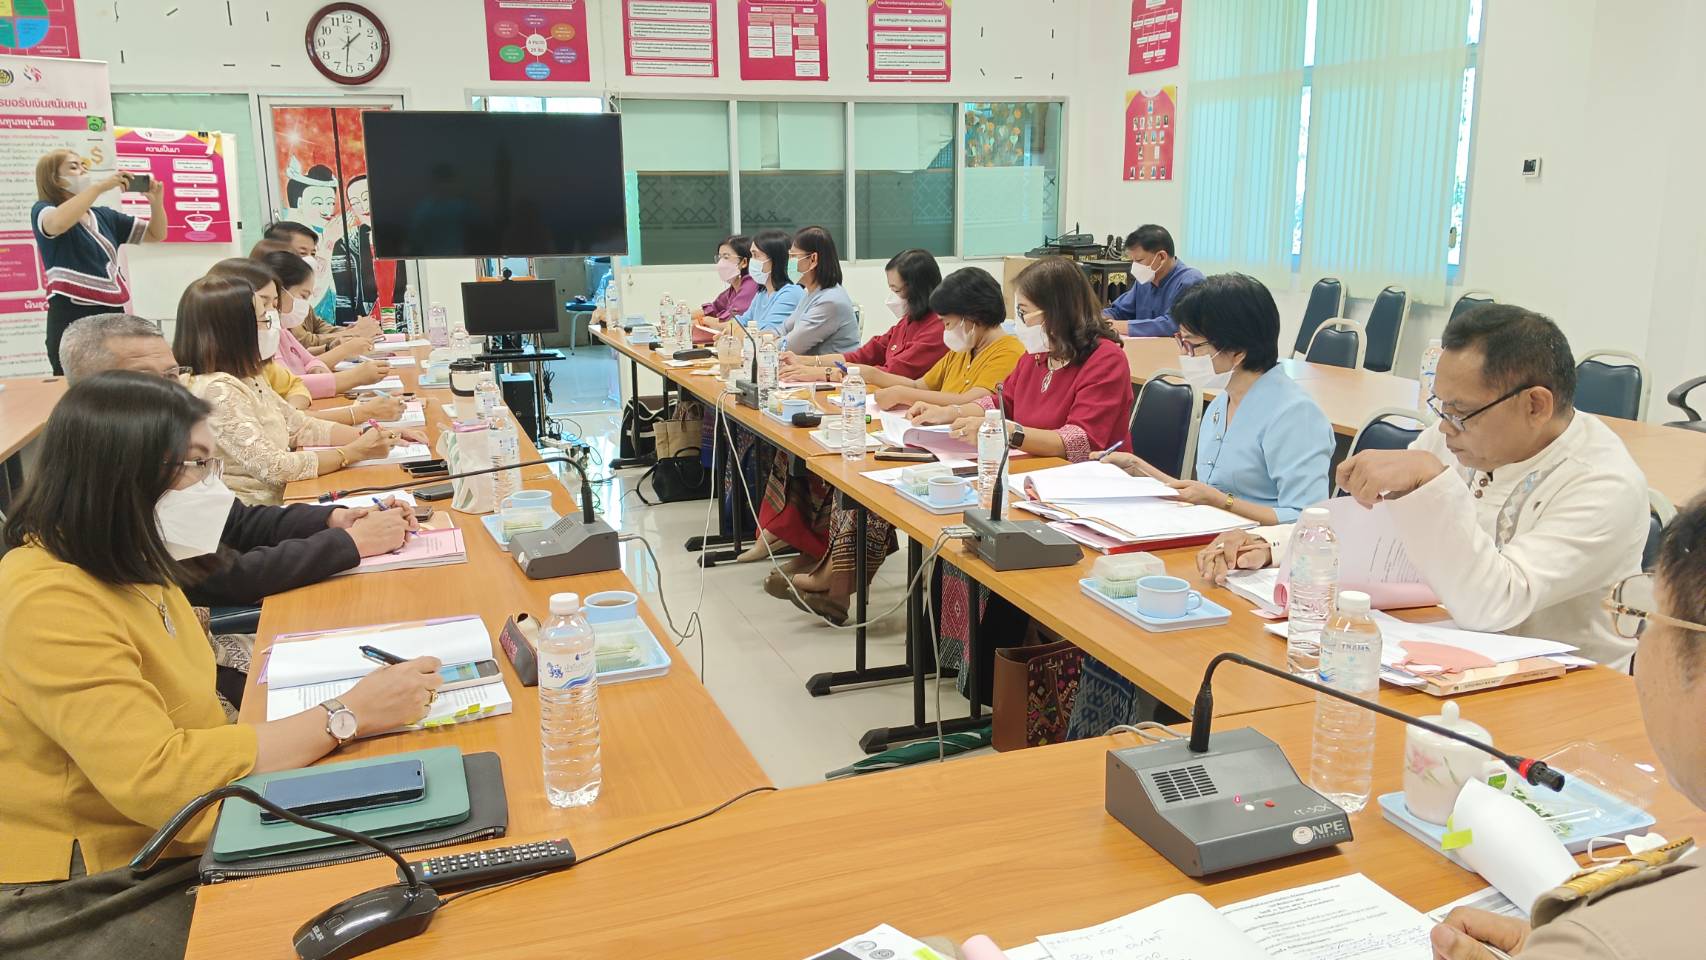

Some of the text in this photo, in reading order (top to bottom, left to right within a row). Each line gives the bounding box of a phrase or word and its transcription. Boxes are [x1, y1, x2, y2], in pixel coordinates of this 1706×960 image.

[331, 17, 340, 27] 11
[341, 14, 353, 23] 12
[321, 26, 332, 35] 10
[366, 28, 374, 38] 2
[317, 38, 326, 47] 9
[370, 41, 379, 50] 3
[322, 51, 331, 60] 8
[366, 53, 374, 63] 4
[333, 61, 341, 71] 7
[356, 62, 366, 71] 5
[145, 144, 181, 153] ความเป็นมา
[1312, 820, 1345, 835] NPE
